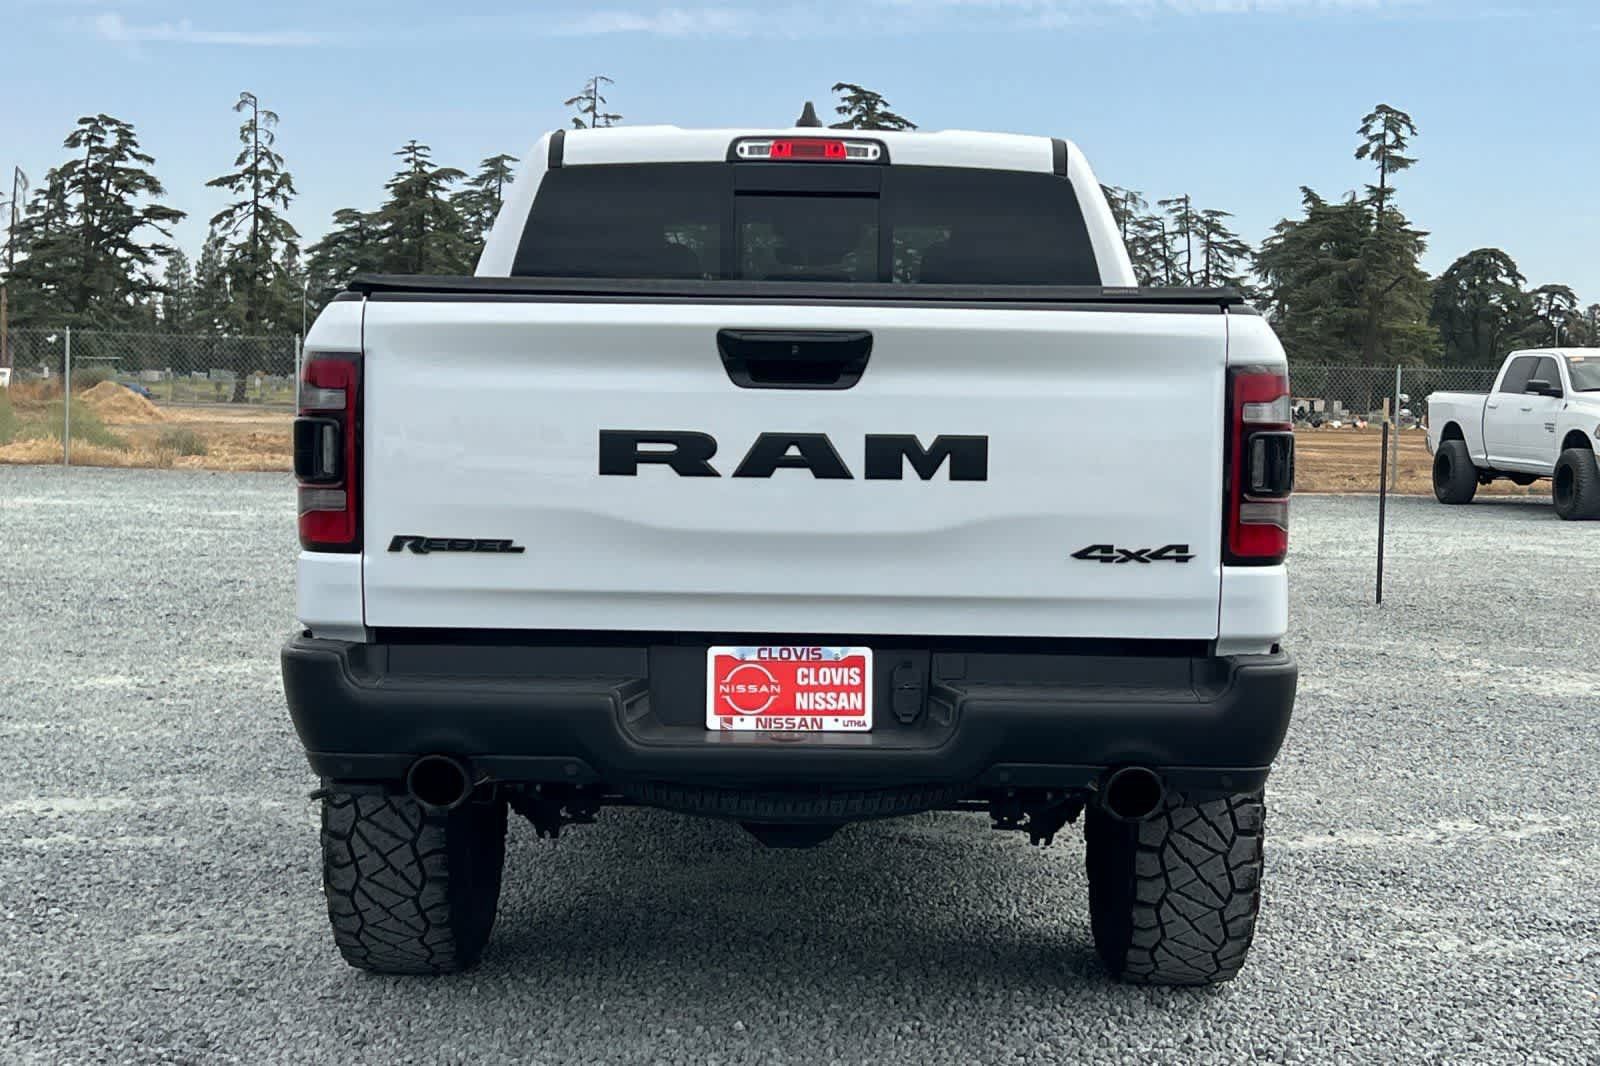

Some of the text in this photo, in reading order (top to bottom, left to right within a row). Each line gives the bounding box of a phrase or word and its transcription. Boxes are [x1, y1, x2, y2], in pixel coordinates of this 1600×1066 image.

[599, 429, 989, 481] RAM
[387, 535, 525, 554] REBEL
[1070, 544, 1196, 563] 4x4
[757, 647, 822, 660] CLOVIS
[797, 667, 860, 686] CLOVIS
[719, 684, 781, 693] NISSAN
[795, 692, 862, 710] NISSAN
[755, 717, 823, 729] NISSAN
